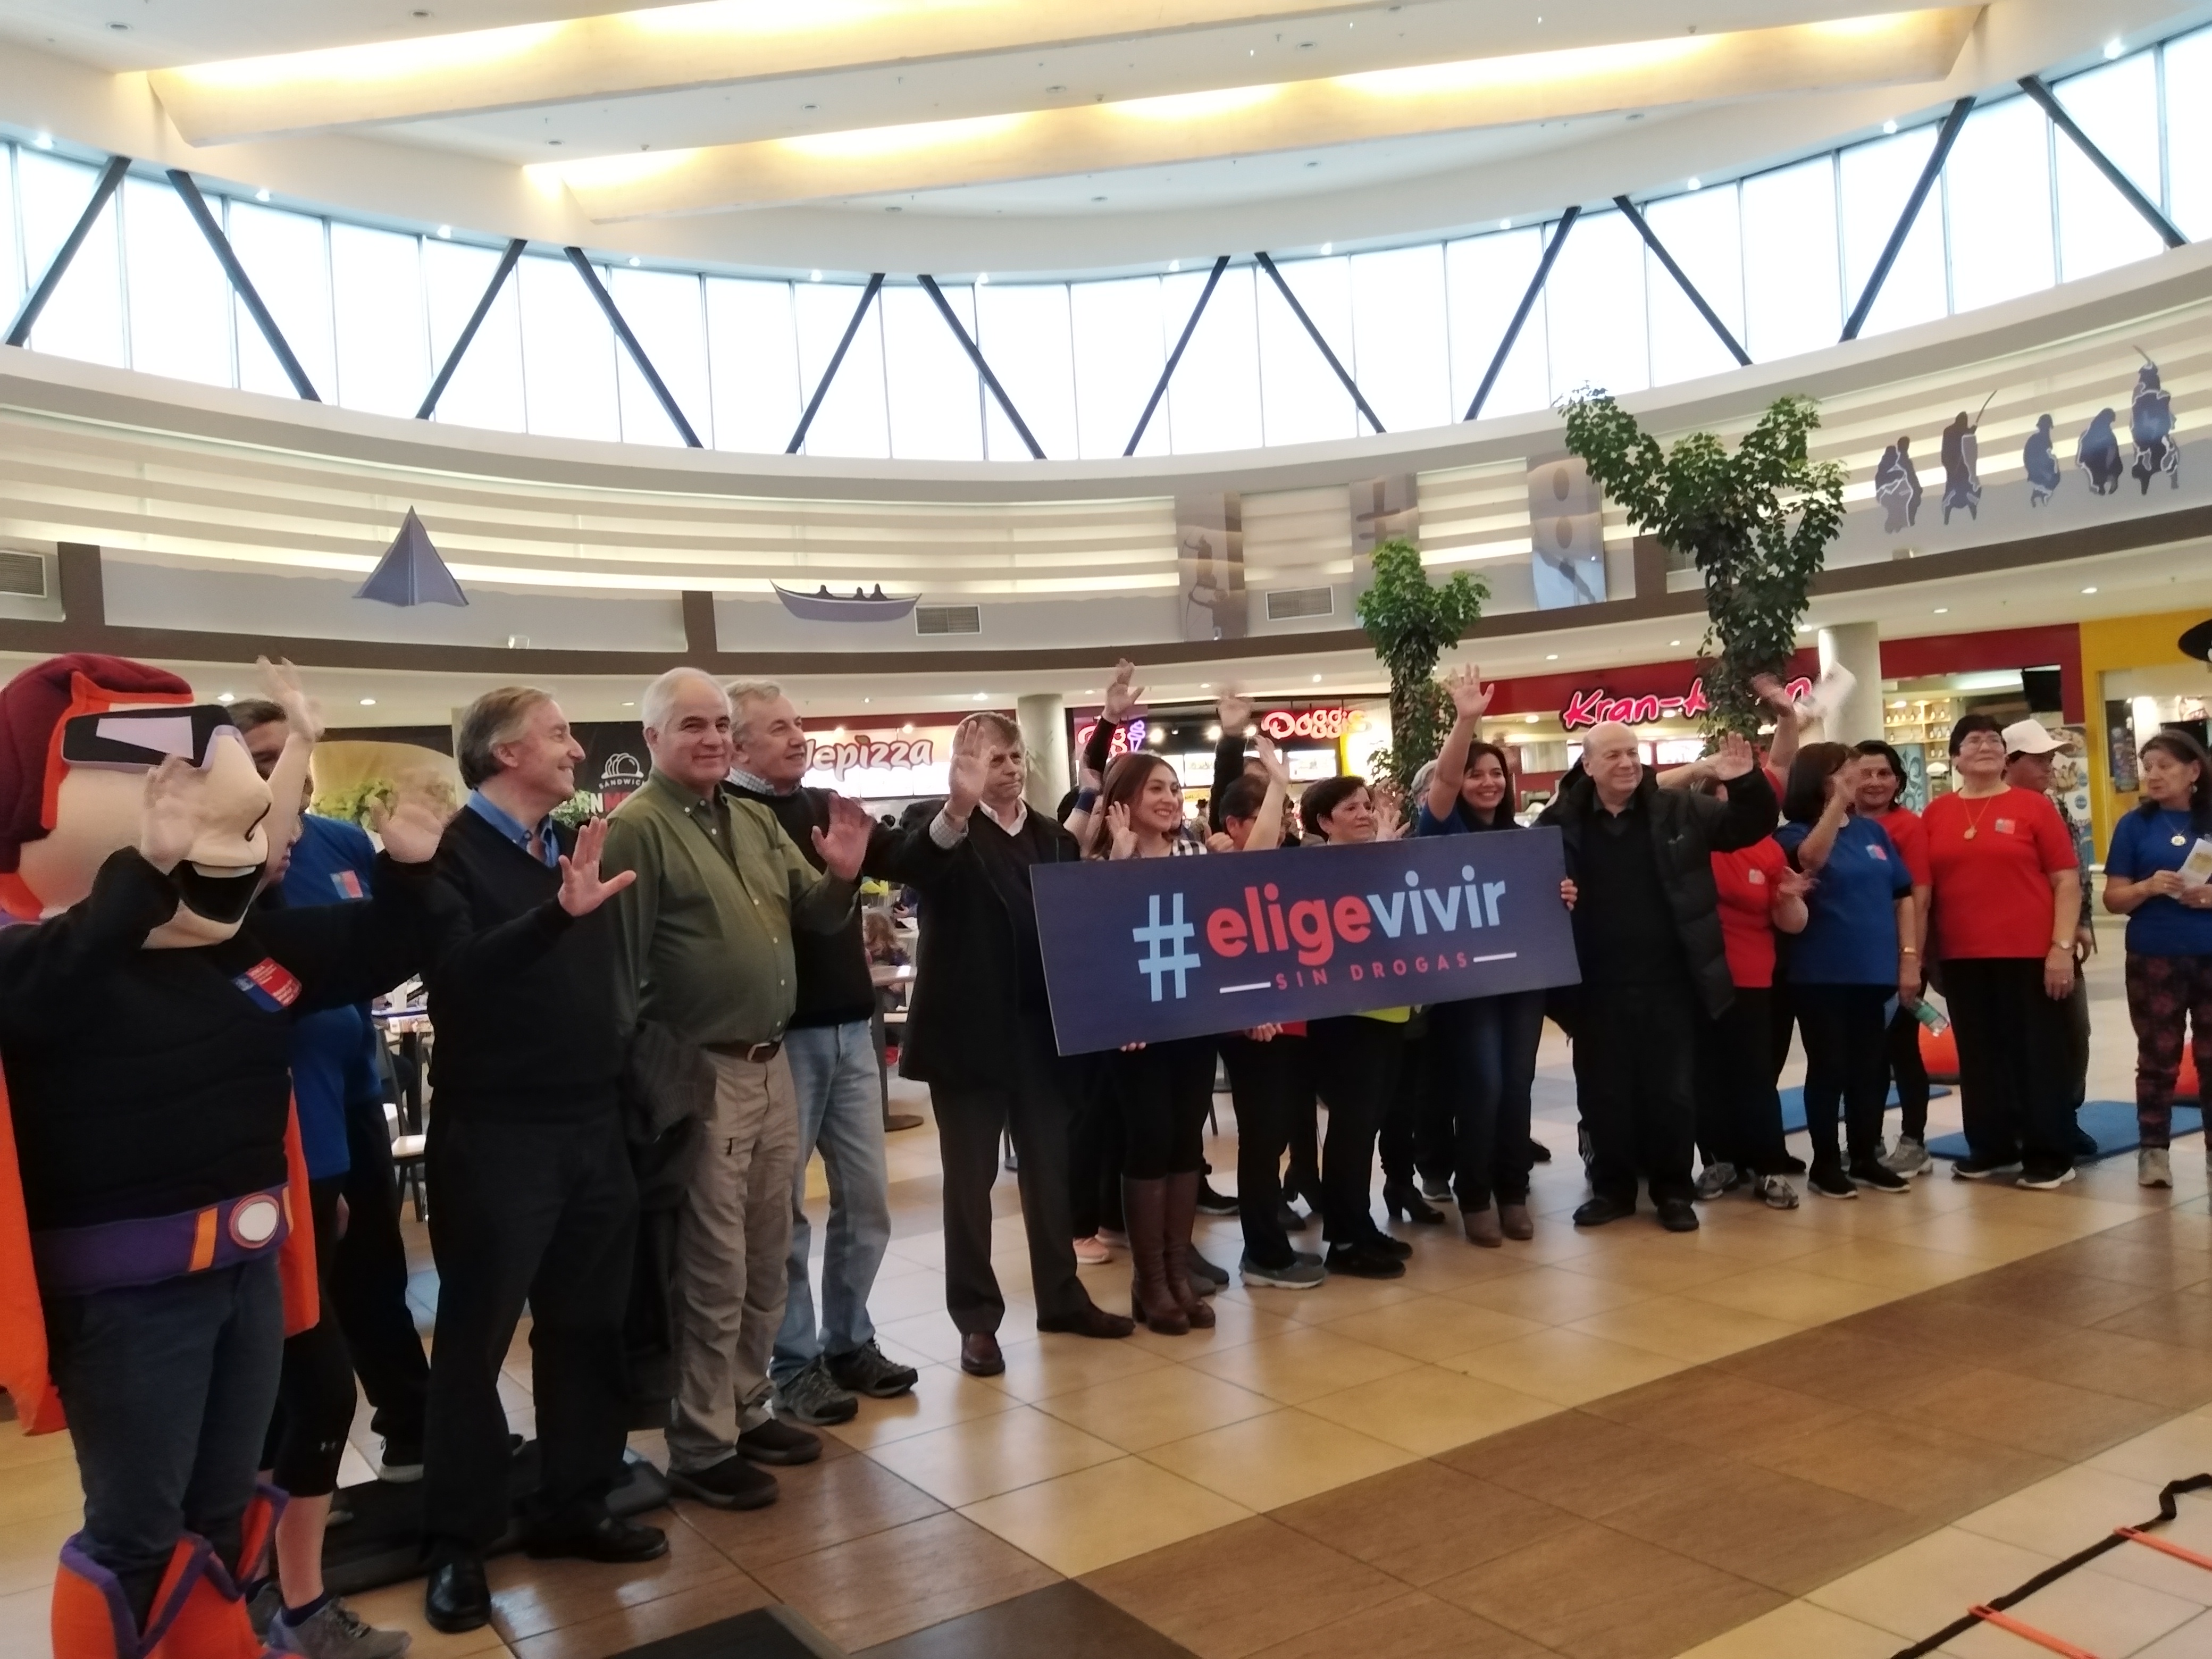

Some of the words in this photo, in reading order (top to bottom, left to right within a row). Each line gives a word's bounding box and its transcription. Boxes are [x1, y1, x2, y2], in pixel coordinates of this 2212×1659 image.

[1261, 708, 1372, 739] Doggis
[1562, 677, 1812, 729] Kran-Kn
[1133, 865, 1506, 1002] #eligevivir
[1276, 969, 1329, 990] SIN
[1350, 952, 1467, 981] DROGAS
